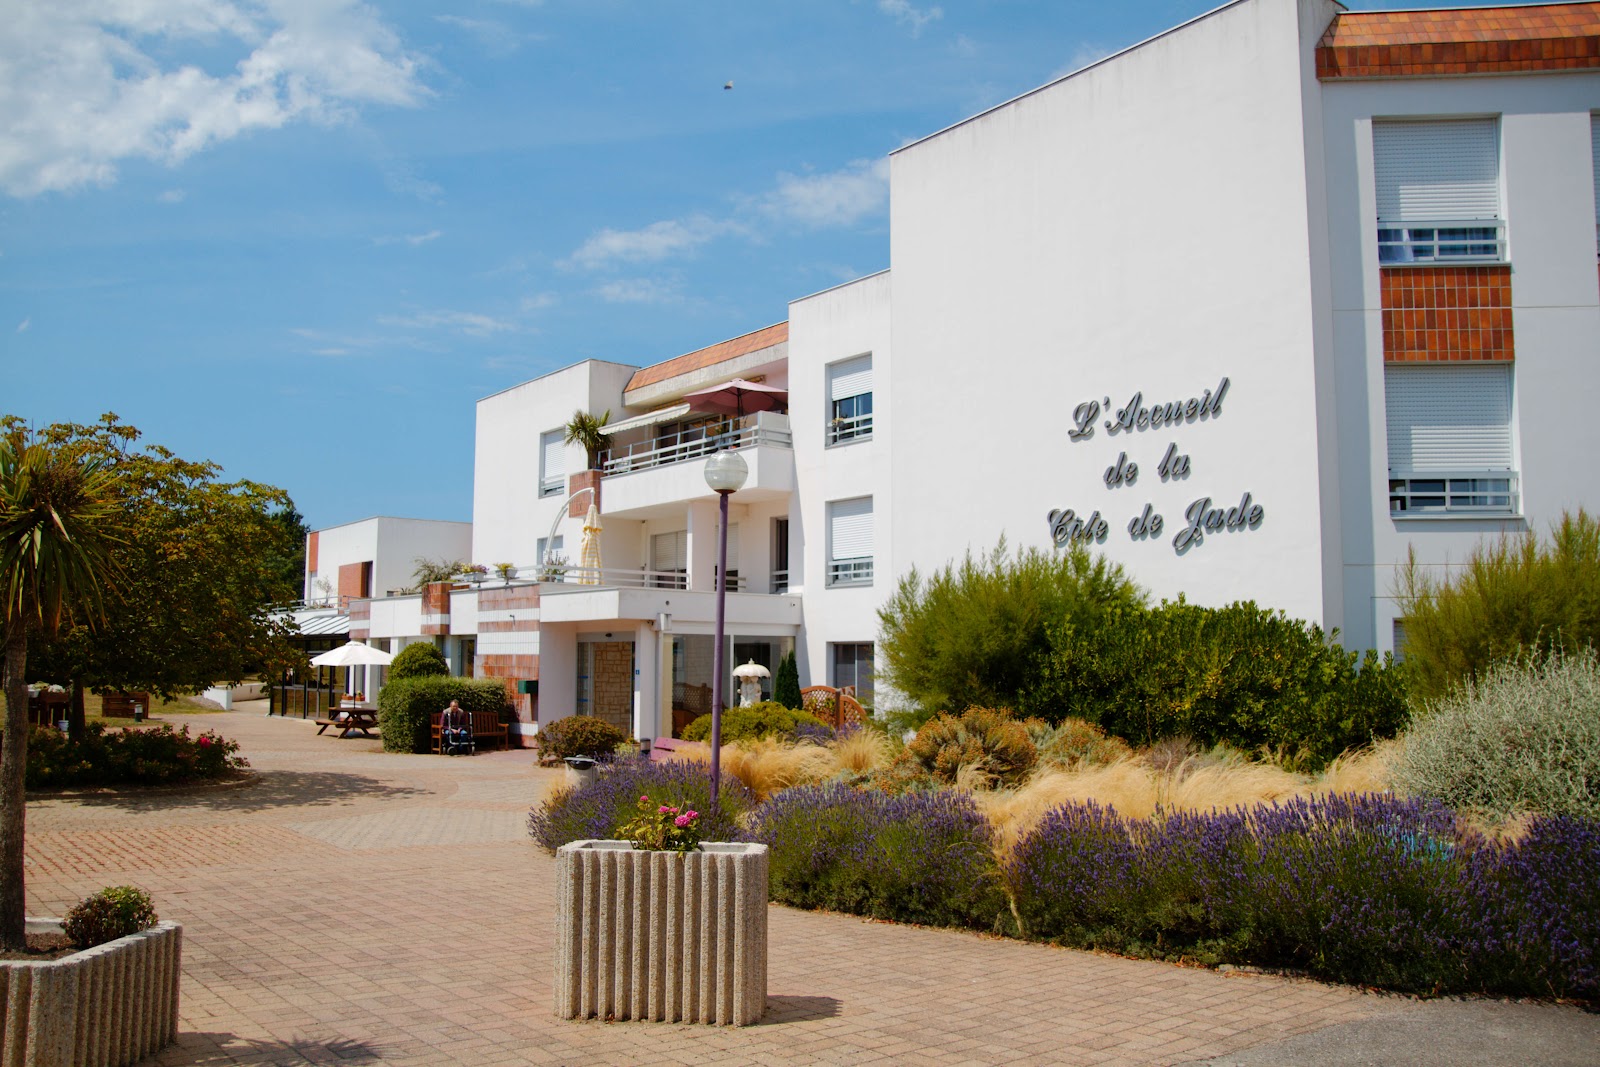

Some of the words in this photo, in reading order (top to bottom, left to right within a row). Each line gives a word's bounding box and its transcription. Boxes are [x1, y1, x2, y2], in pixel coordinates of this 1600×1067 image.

[1068, 376, 1230, 438] L'Accueil
[1104, 451, 1138, 484] de
[1157, 442, 1190, 478] la
[1127, 502, 1163, 537] de
[1172, 491, 1264, 551] Jade
